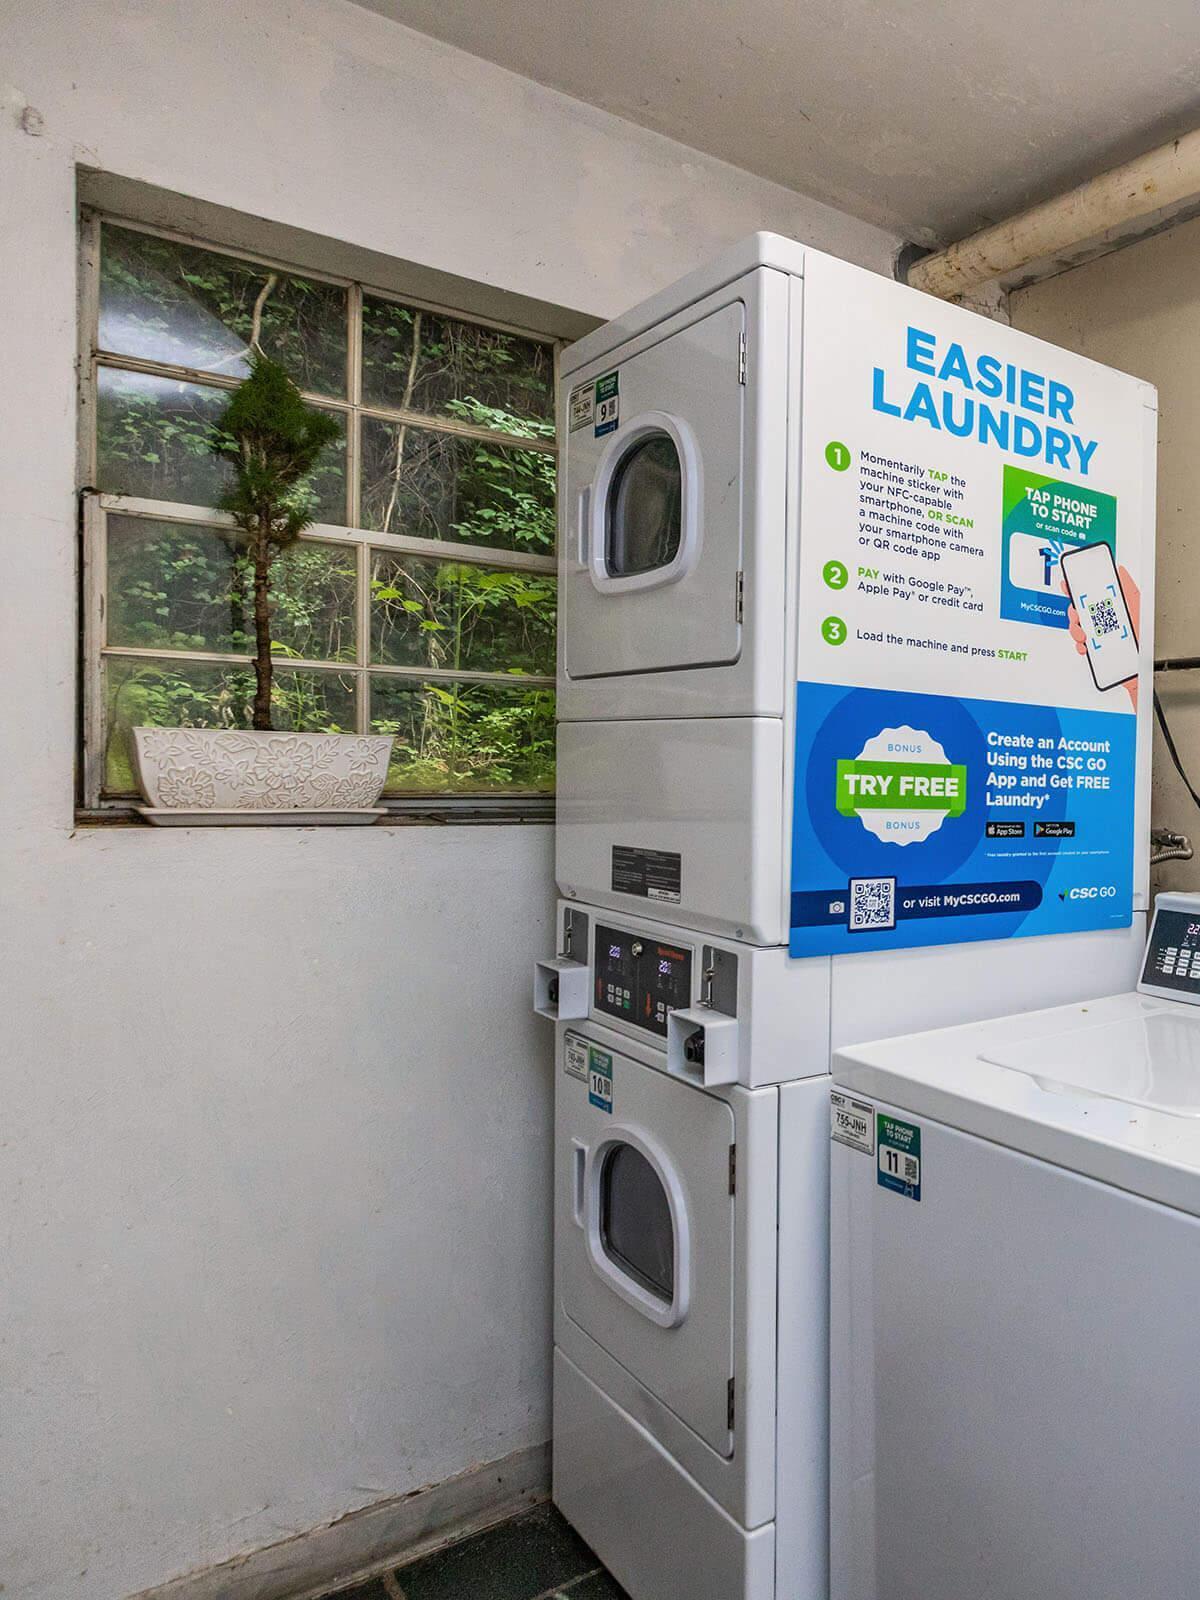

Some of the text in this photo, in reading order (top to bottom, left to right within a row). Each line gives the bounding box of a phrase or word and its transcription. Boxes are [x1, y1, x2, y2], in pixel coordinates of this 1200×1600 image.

[906, 325, 1073, 425] EASIER
[872, 366, 1098, 478] LAUNDRY
[833, 447, 841, 465] 1
[860, 449, 965, 487] Momentarily TAP the
[860, 464, 963, 500] machine sticker with
[859, 480, 952, 511] your NFC-capable
[1025, 486, 1097, 517] TAP PHONE
[859, 492, 974, 529] smartphone, OR SCAN
[1030, 502, 1091, 529] TO START
[859, 508, 963, 539] a machine code with
[1045, 523, 1058, 533] scan
[1061, 527, 1076, 537] code
[859, 522, 983, 557] your smartphone camera
[859, 536, 940, 562] or QR code app
[830, 566, 840, 584] 2
[858, 566, 879, 579] PAY
[883, 570, 904, 584] with
[908, 575, 943, 593] Google
[857, 580, 889, 597] Apple
[918, 593, 928, 602] or
[931, 594, 959, 608] credit
[963, 599, 983, 612] card
[828, 622, 839, 639] 3
[857, 628, 1026, 661] Load the machine and press START
[887, 743, 921, 753] BONUS
[987, 731, 1110, 753] Create an Account
[987, 751, 1106, 771] Using the CSC GO
[843, 773, 958, 797] TRY FREE
[986, 772, 1109, 789] App and Get FREE
[886, 821, 920, 829] BONUS
[1045, 827, 1072, 835] Google Play
[903, 890, 1020, 908] or visit MyCSCGO.com
[1069, 886, 1115, 899] CSC GO
[593, 1075, 603, 1094] 10
[886, 1150, 898, 1174] 11
